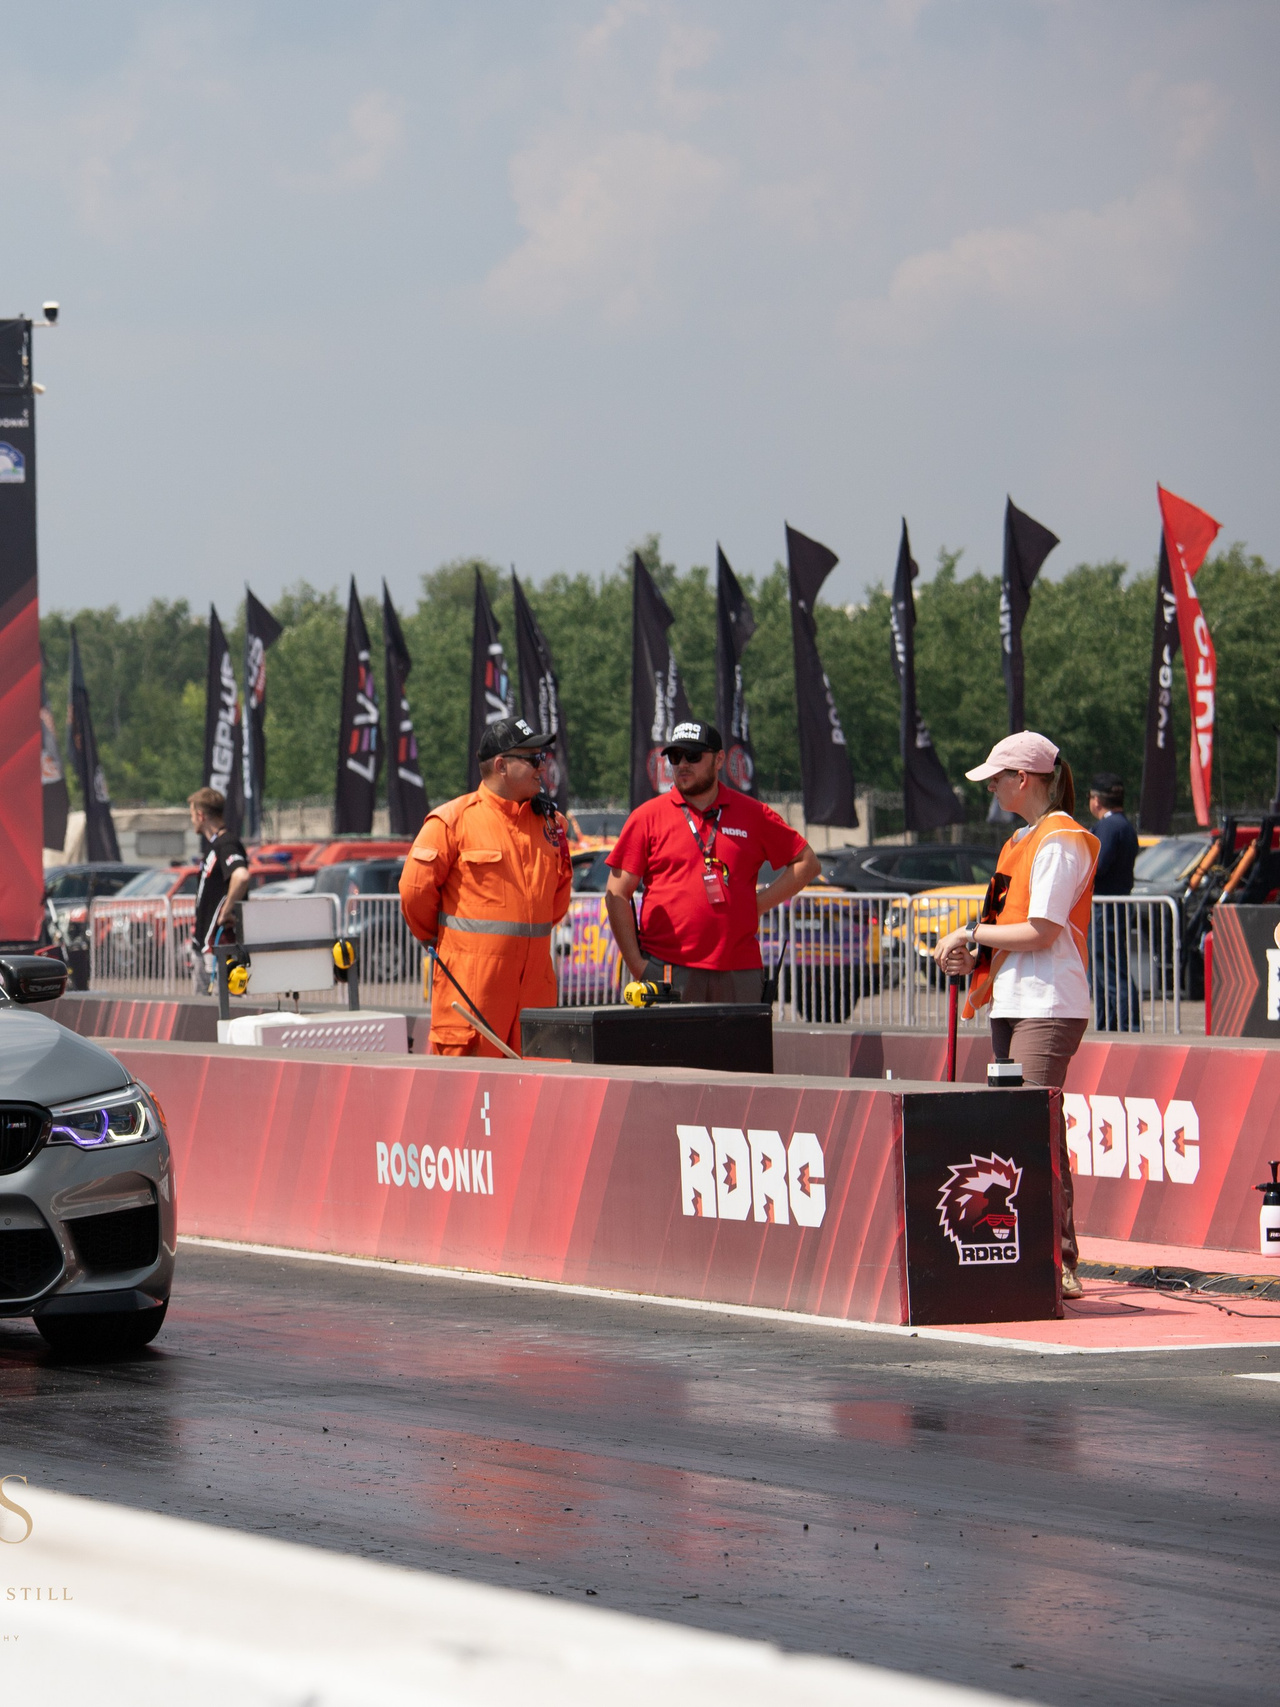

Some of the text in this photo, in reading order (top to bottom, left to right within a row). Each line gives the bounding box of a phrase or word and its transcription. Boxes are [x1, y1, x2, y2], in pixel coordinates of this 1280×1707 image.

[376, 1141, 494, 1195] ROSGONKI
[1063, 1093, 1200, 1184] RDRC
[676, 1124, 826, 1228] RDRC
[961, 1245, 1017, 1262] RDRC
